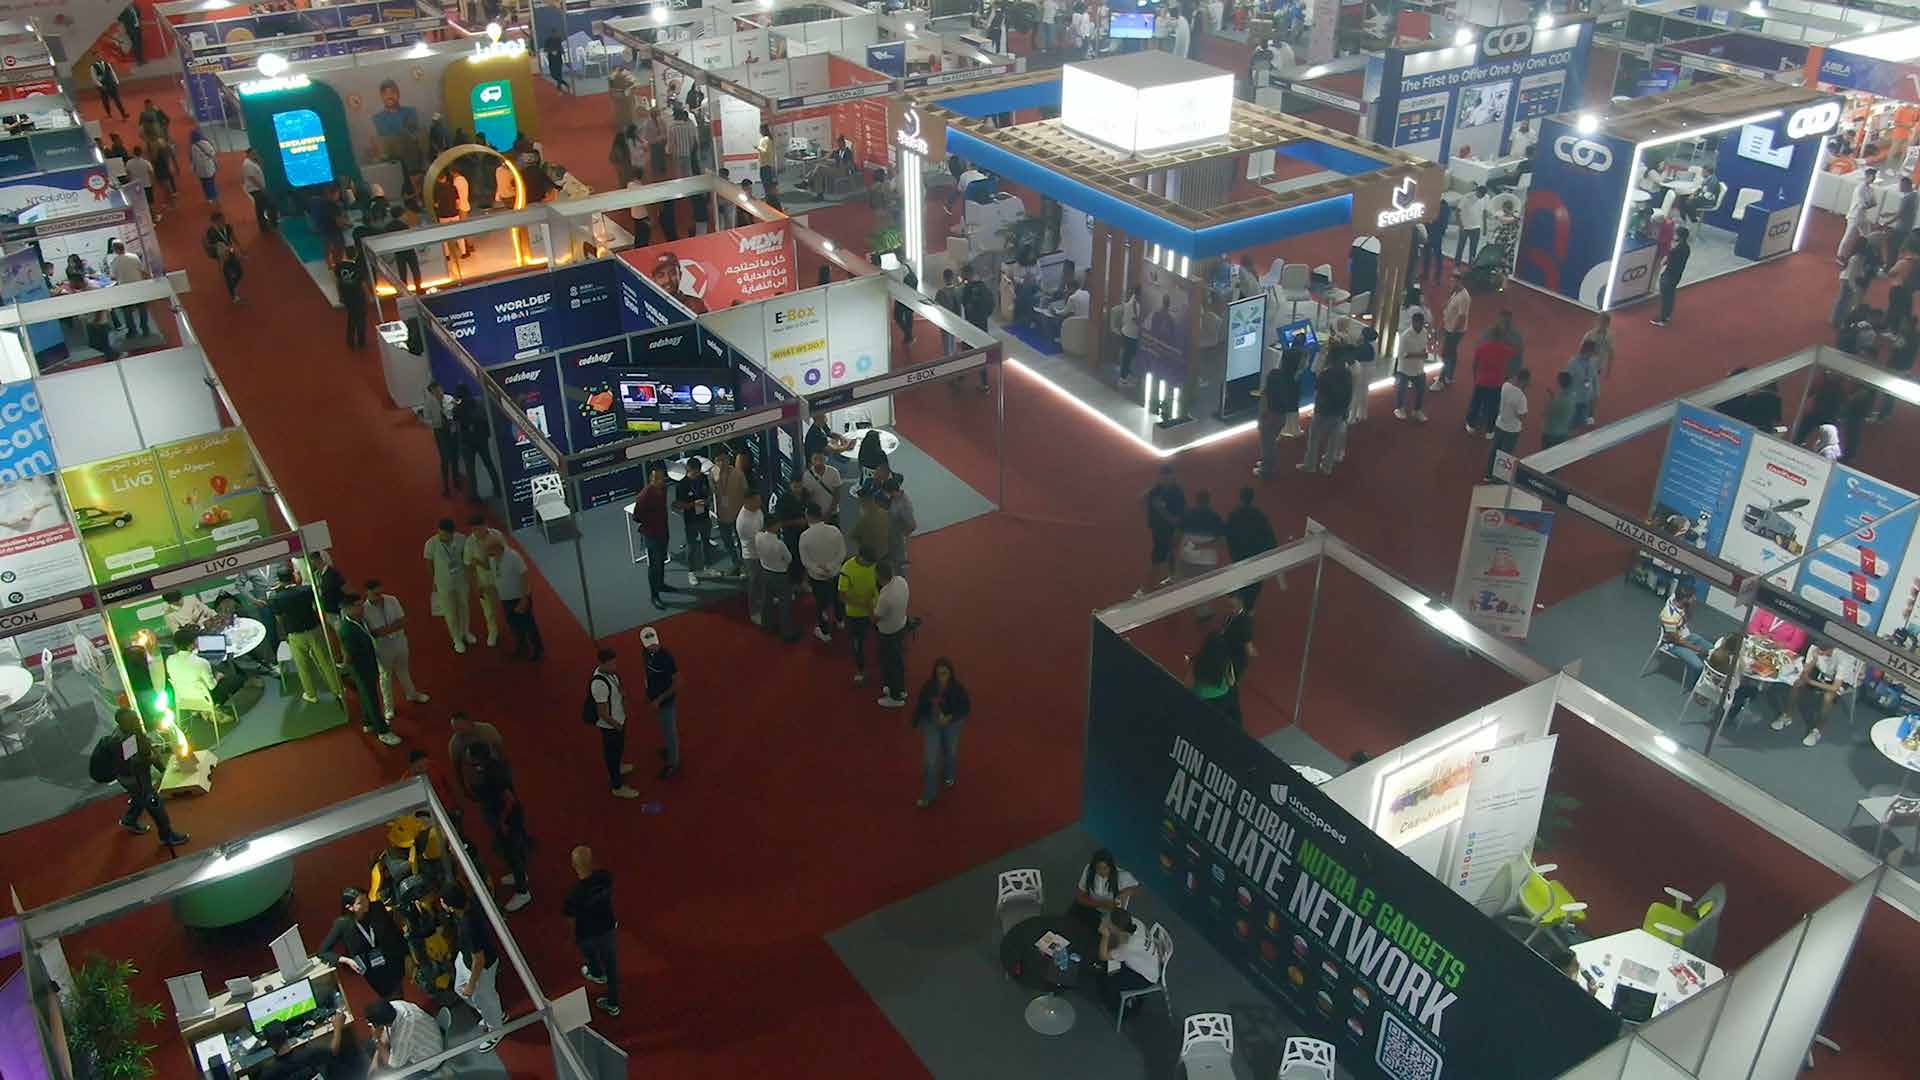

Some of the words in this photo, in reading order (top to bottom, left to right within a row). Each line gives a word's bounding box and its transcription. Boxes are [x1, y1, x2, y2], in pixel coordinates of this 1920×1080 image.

[1401, 80, 1421, 92] The
[1423, 75, 1446, 90] First
[1448, 73, 1459, 85] to
[1460, 68, 1488, 83] Offer
[1489, 64, 1511, 77] One
[1512, 61, 1526, 75] by
[1526, 58, 1547, 70] One
[1549, 52, 1571, 65] COD
[494, 292, 552, 314] WORLDEF
[675, 421, 737, 446] CODSHOPY
[1615, 519, 1656, 548] HAZAR
[1657, 541, 1679, 557] GO
[205, 556, 239, 574] LIVO
[1168, 735, 1205, 773] JOIN
[1203, 760, 1238, 807] OUR
[1236, 789, 1297, 856] GLOBAL
[1164, 767, 1293, 900] AFFILIATE
[1287, 871, 1458, 1037] NETWORK
[1297, 838, 1360, 906] NUTRA
[1357, 886, 1377, 917] &
[1374, 900, 1466, 991] GADGETS
